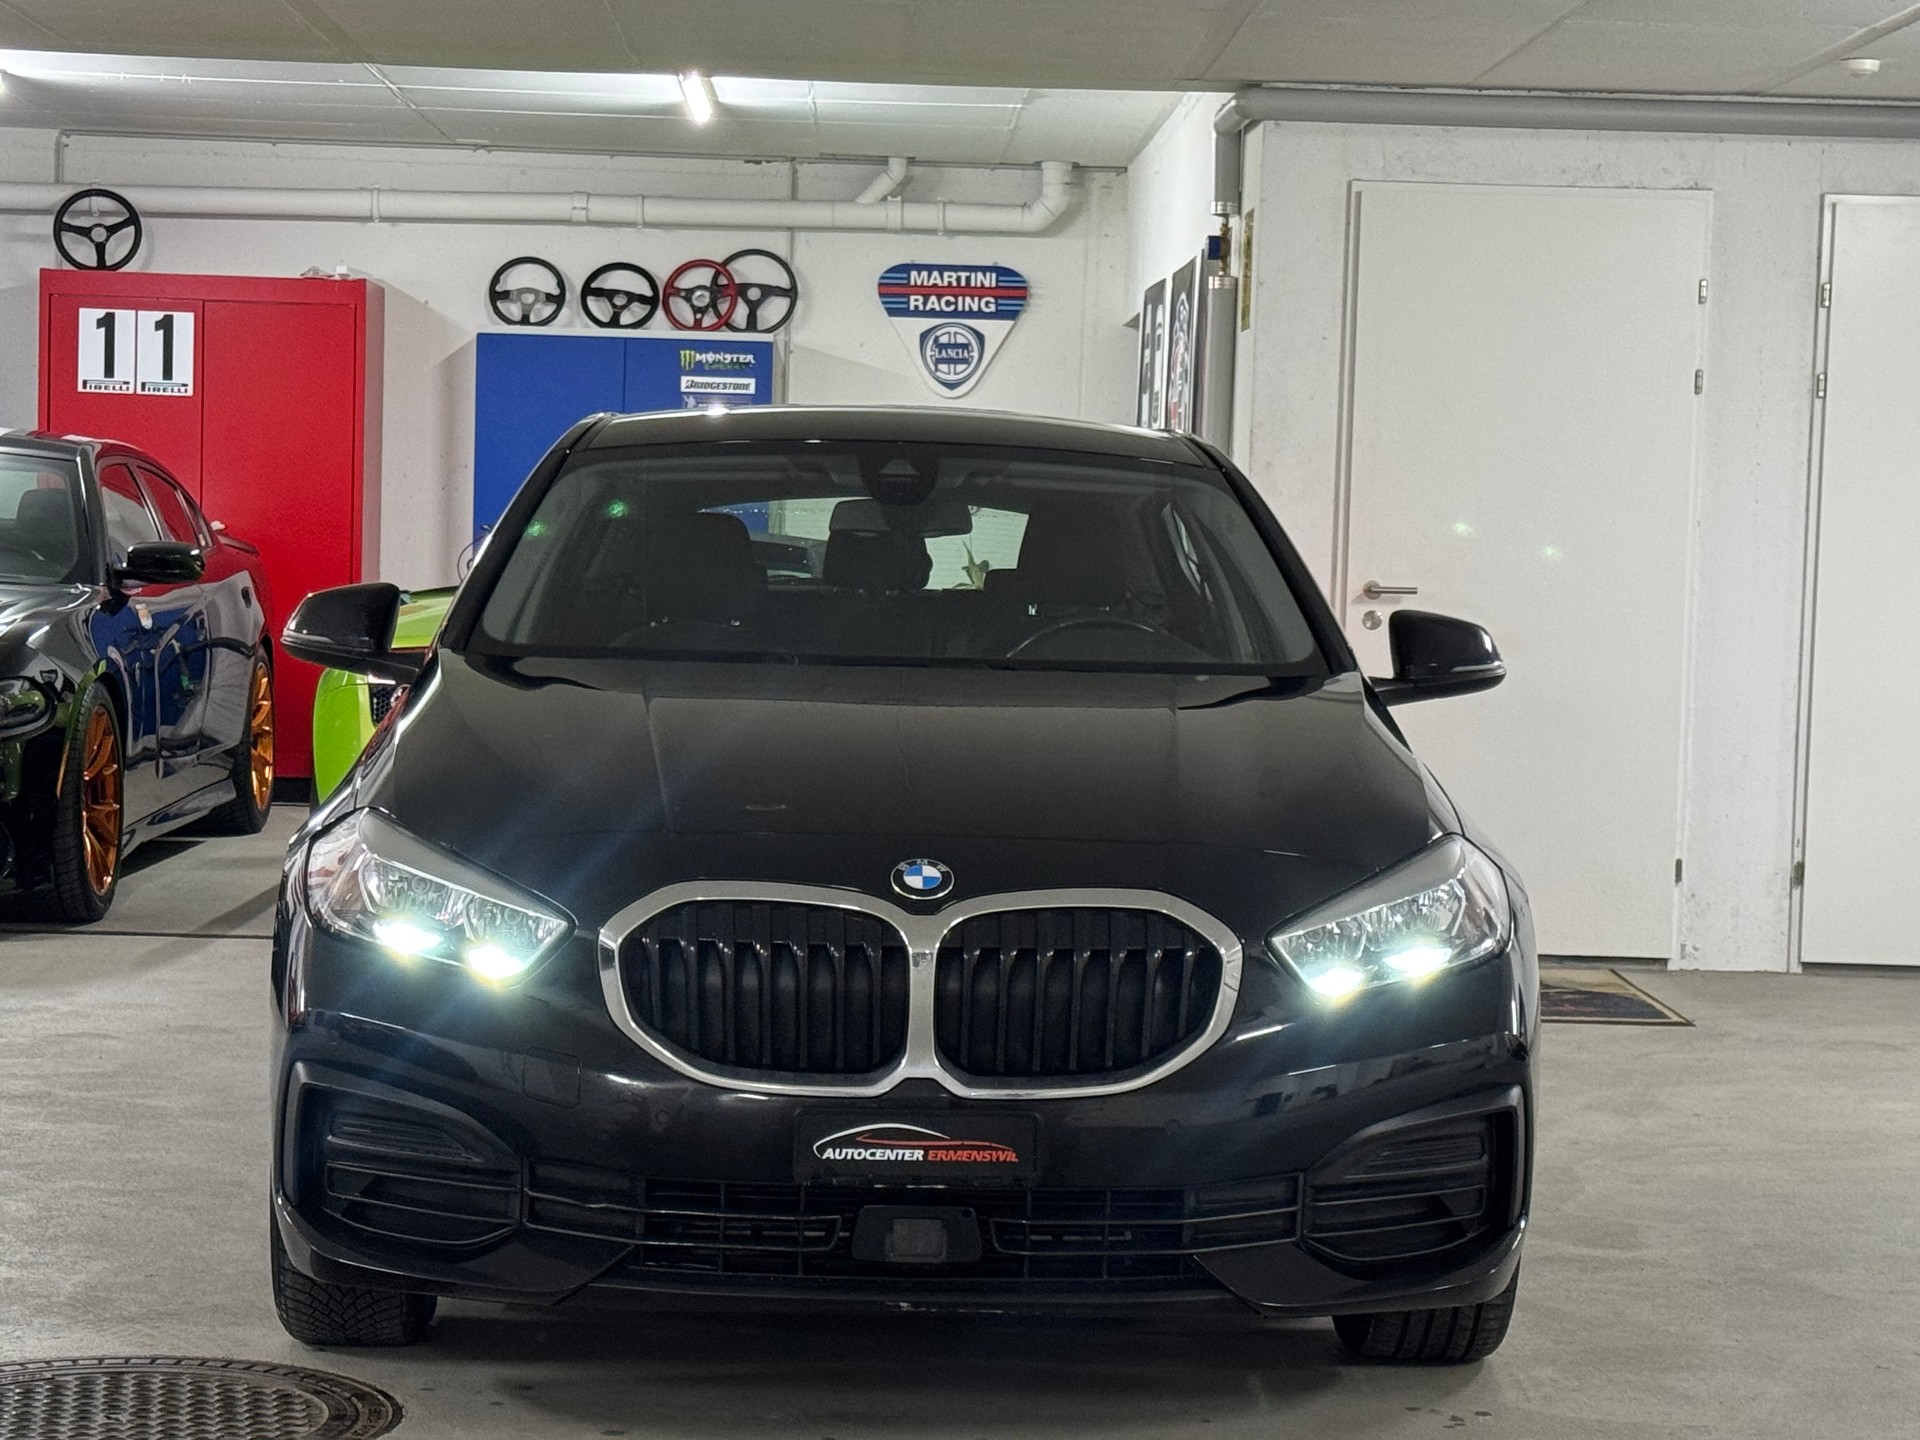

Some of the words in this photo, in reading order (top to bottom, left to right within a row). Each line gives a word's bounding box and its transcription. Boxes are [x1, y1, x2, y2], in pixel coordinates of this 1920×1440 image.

[909, 270, 997, 288] MARTINI
[908, 295, 997, 313] RACING
[695, 351, 756, 364] MONSTER
[935, 347, 969, 359] LANCIA
[82, 379, 131, 392] PIRELLI
[140, 381, 189, 394] PIRELLI
[683, 379, 752, 391] BRIDGESTONE
[821, 1147, 925, 1162] AUTOCENTER
[927, 1149, 1019, 1163] ERMENSWIL
